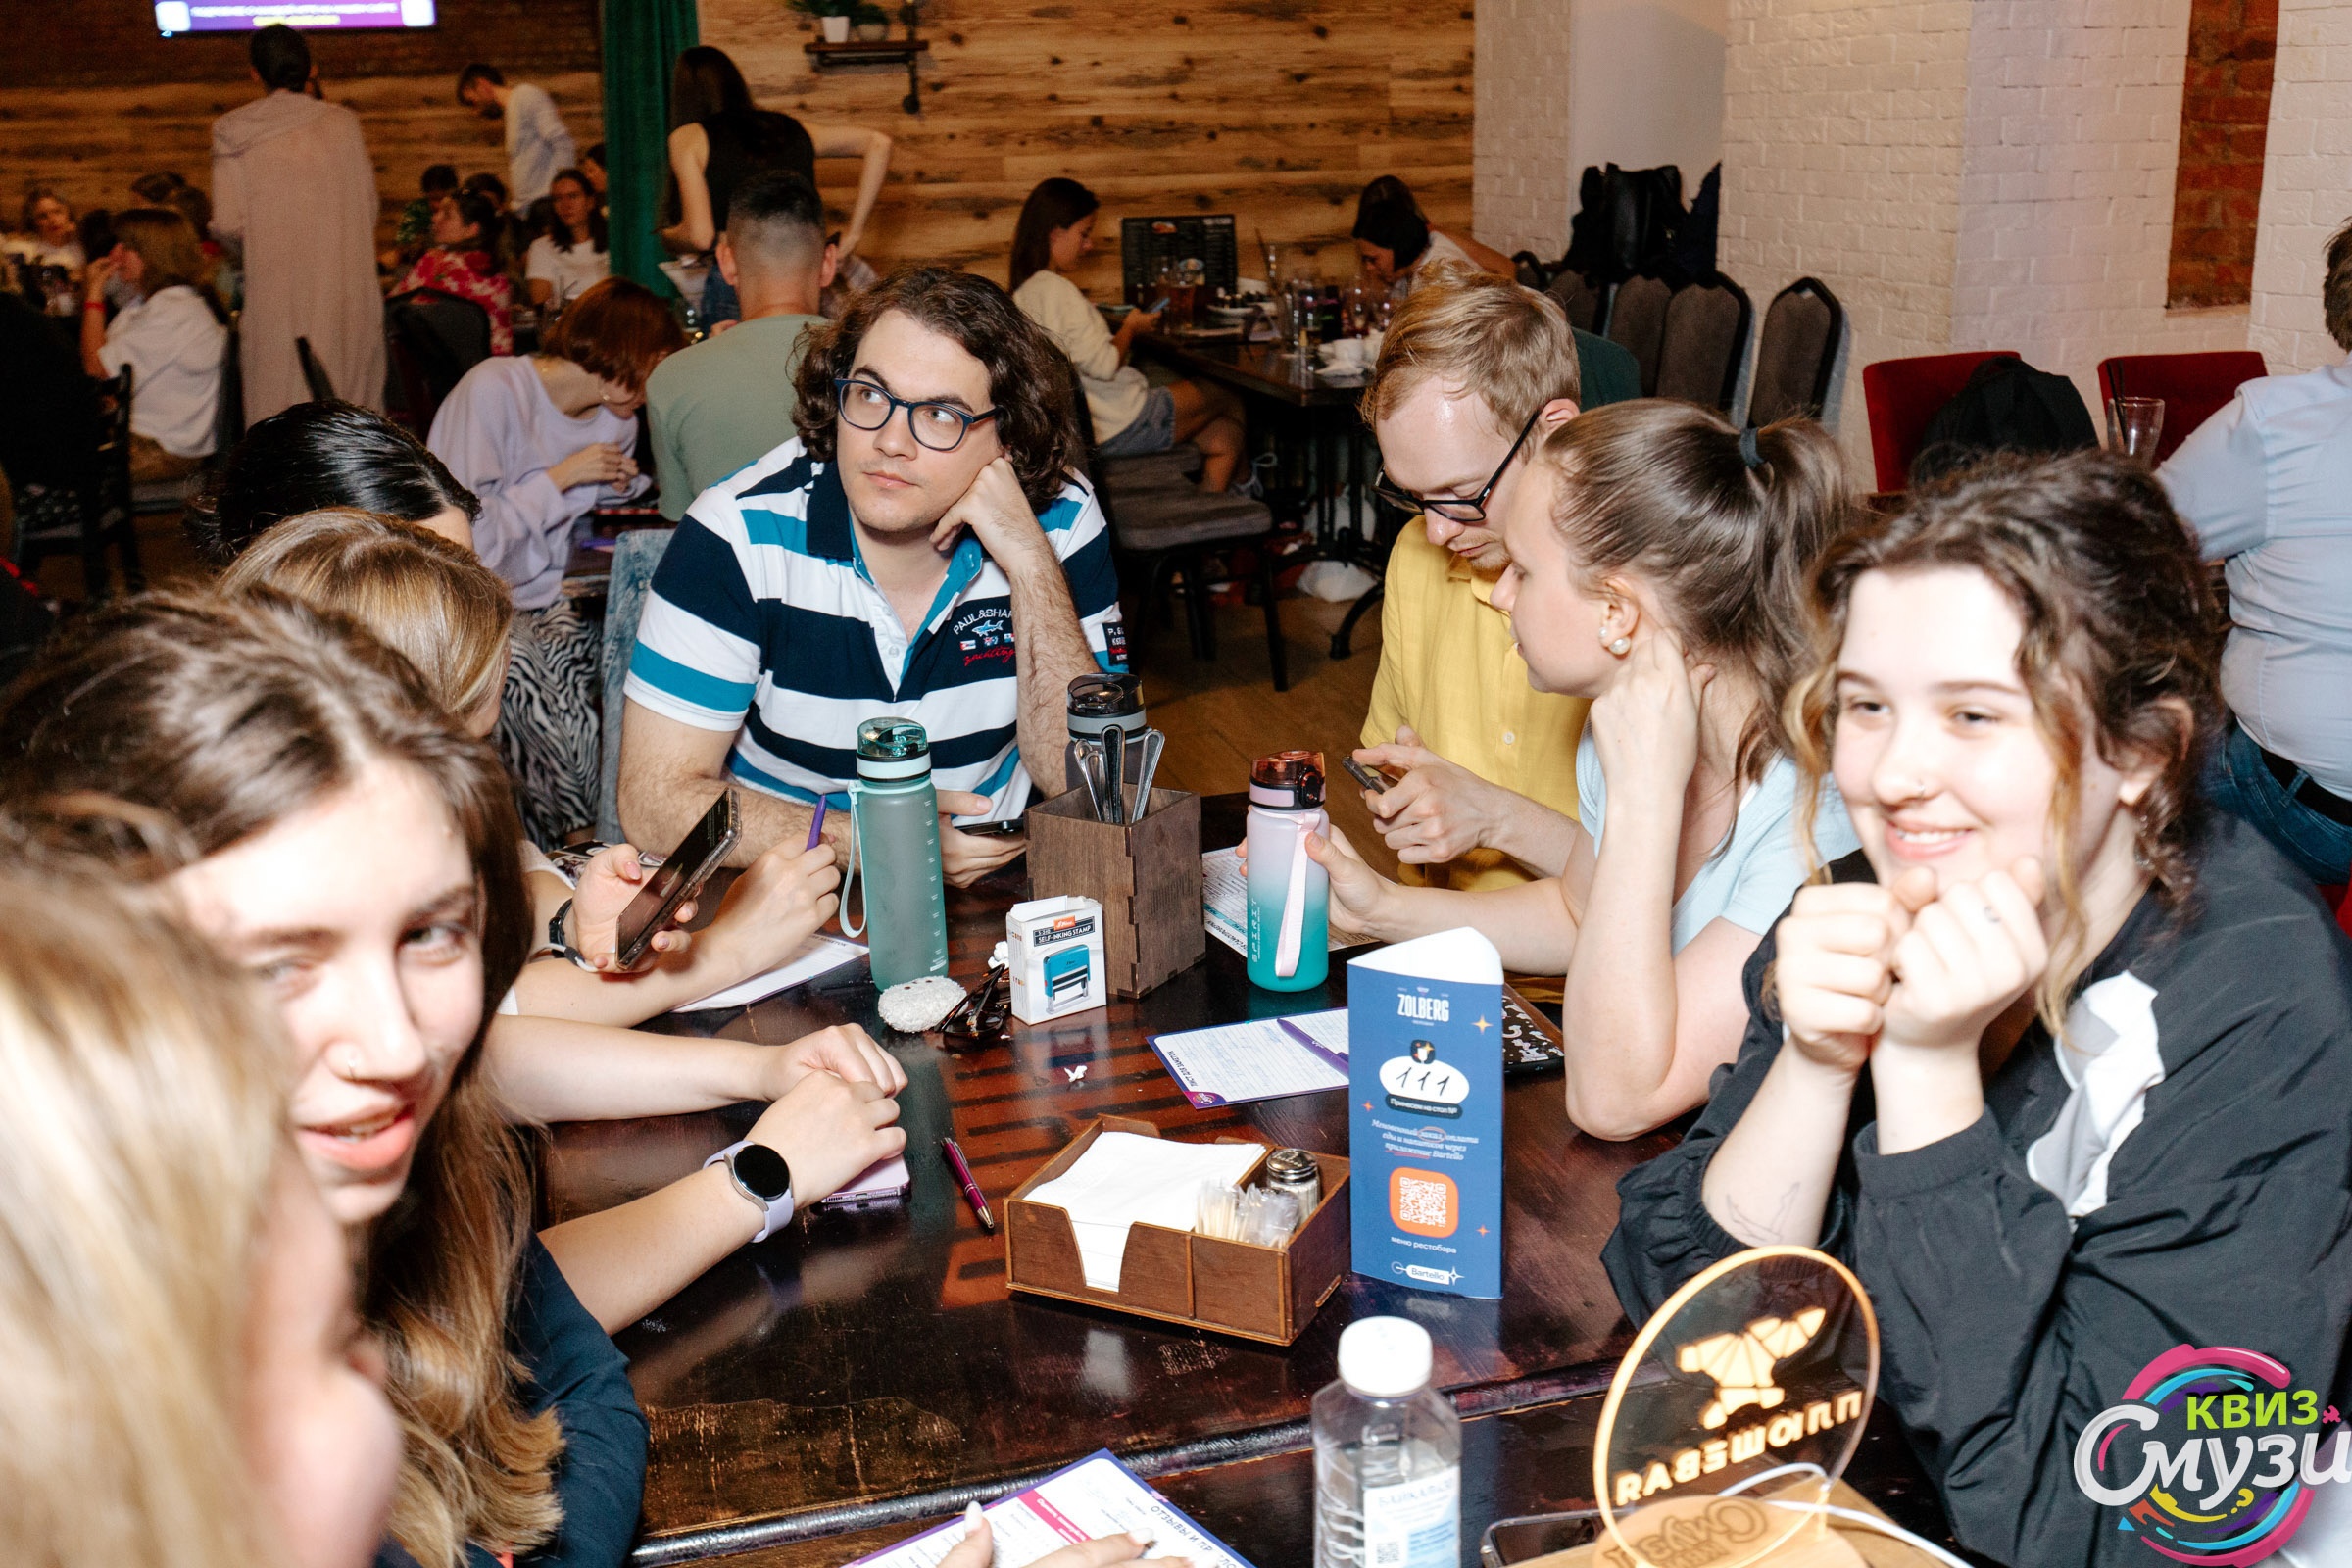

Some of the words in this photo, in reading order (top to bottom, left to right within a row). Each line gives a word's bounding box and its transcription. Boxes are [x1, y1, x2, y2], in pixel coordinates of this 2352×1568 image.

[1038, 930, 1073, 943] SELF-INKING
[1072, 924, 1092, 935] STAMP
[1396, 993, 1449, 1022] ZOLBERG
[1391, 1236, 1412, 1246] меню
[1412, 1242, 1457, 1254] рестобара
[1411, 1267, 1445, 1281] Bartello
[1151, 1505, 1191, 1536] ОТЗЫВЫ
